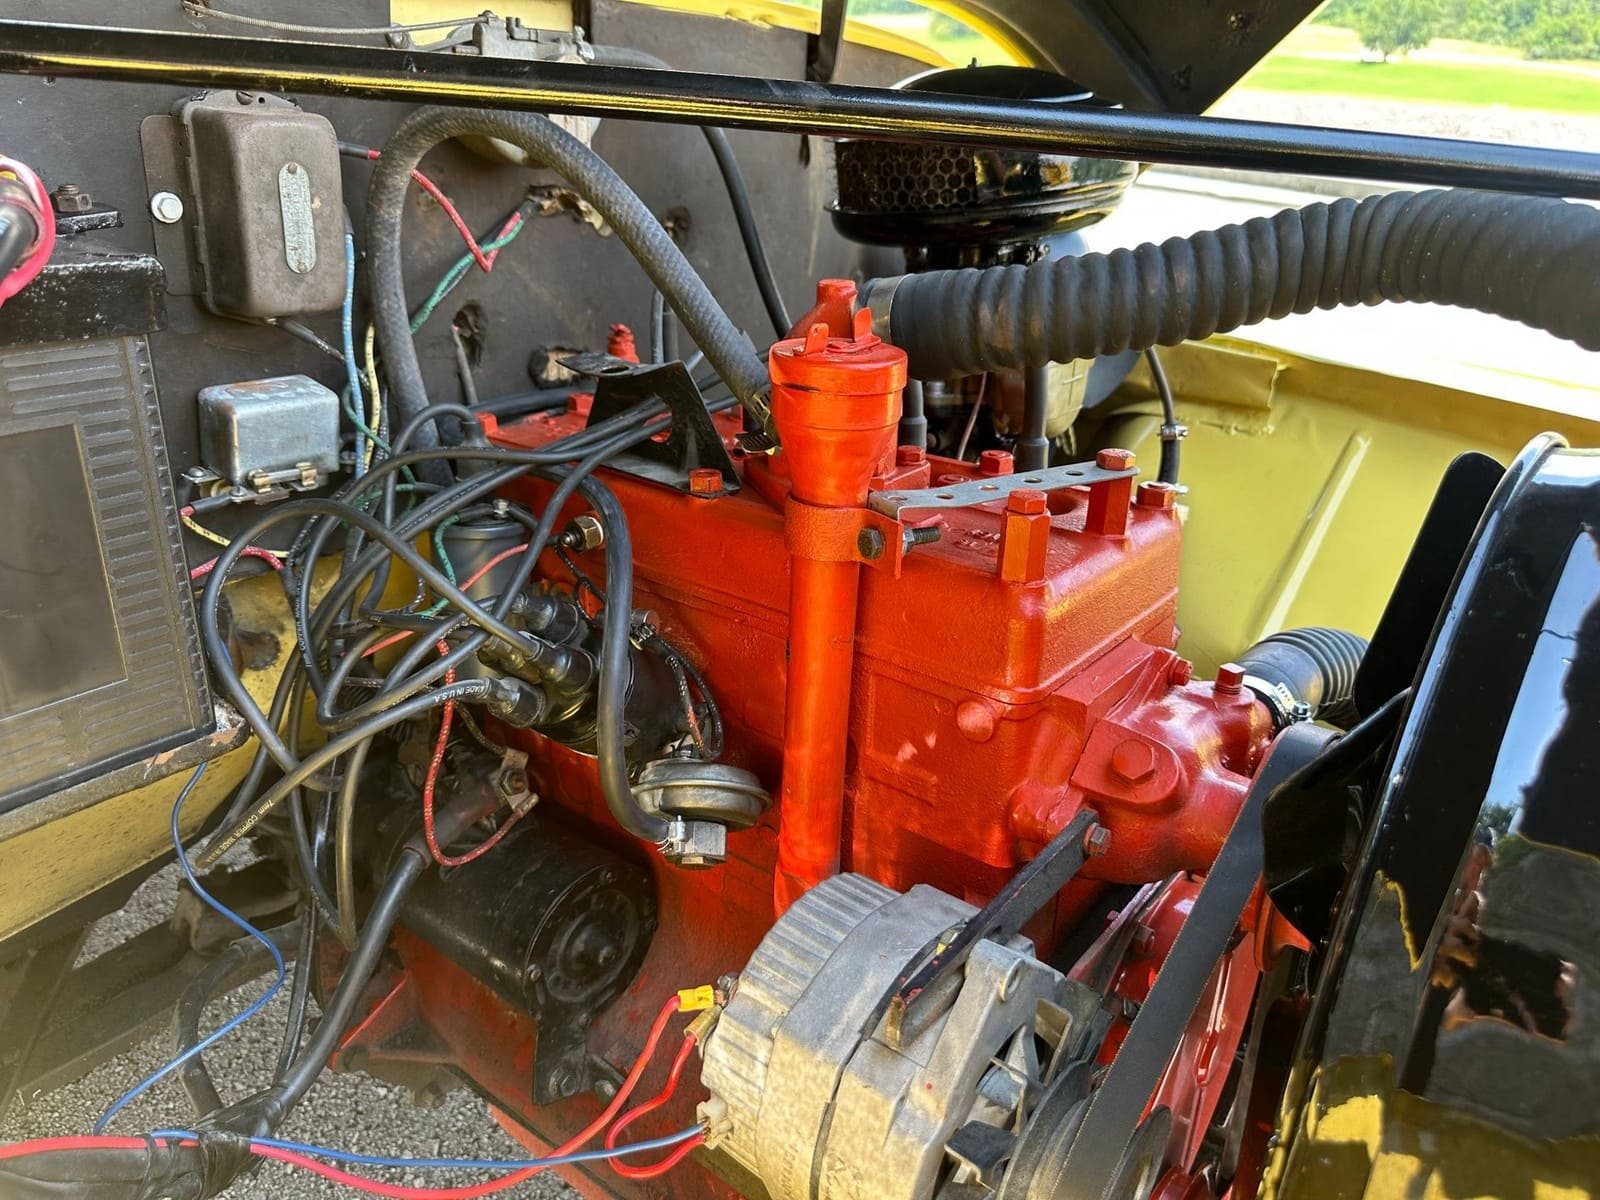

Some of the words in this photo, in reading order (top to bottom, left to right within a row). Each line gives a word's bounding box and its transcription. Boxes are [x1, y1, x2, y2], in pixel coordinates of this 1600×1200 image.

[457, 687, 465, 696] IN
[258, 799, 275, 815] 7mm
[233, 814, 258, 837] COPPER
